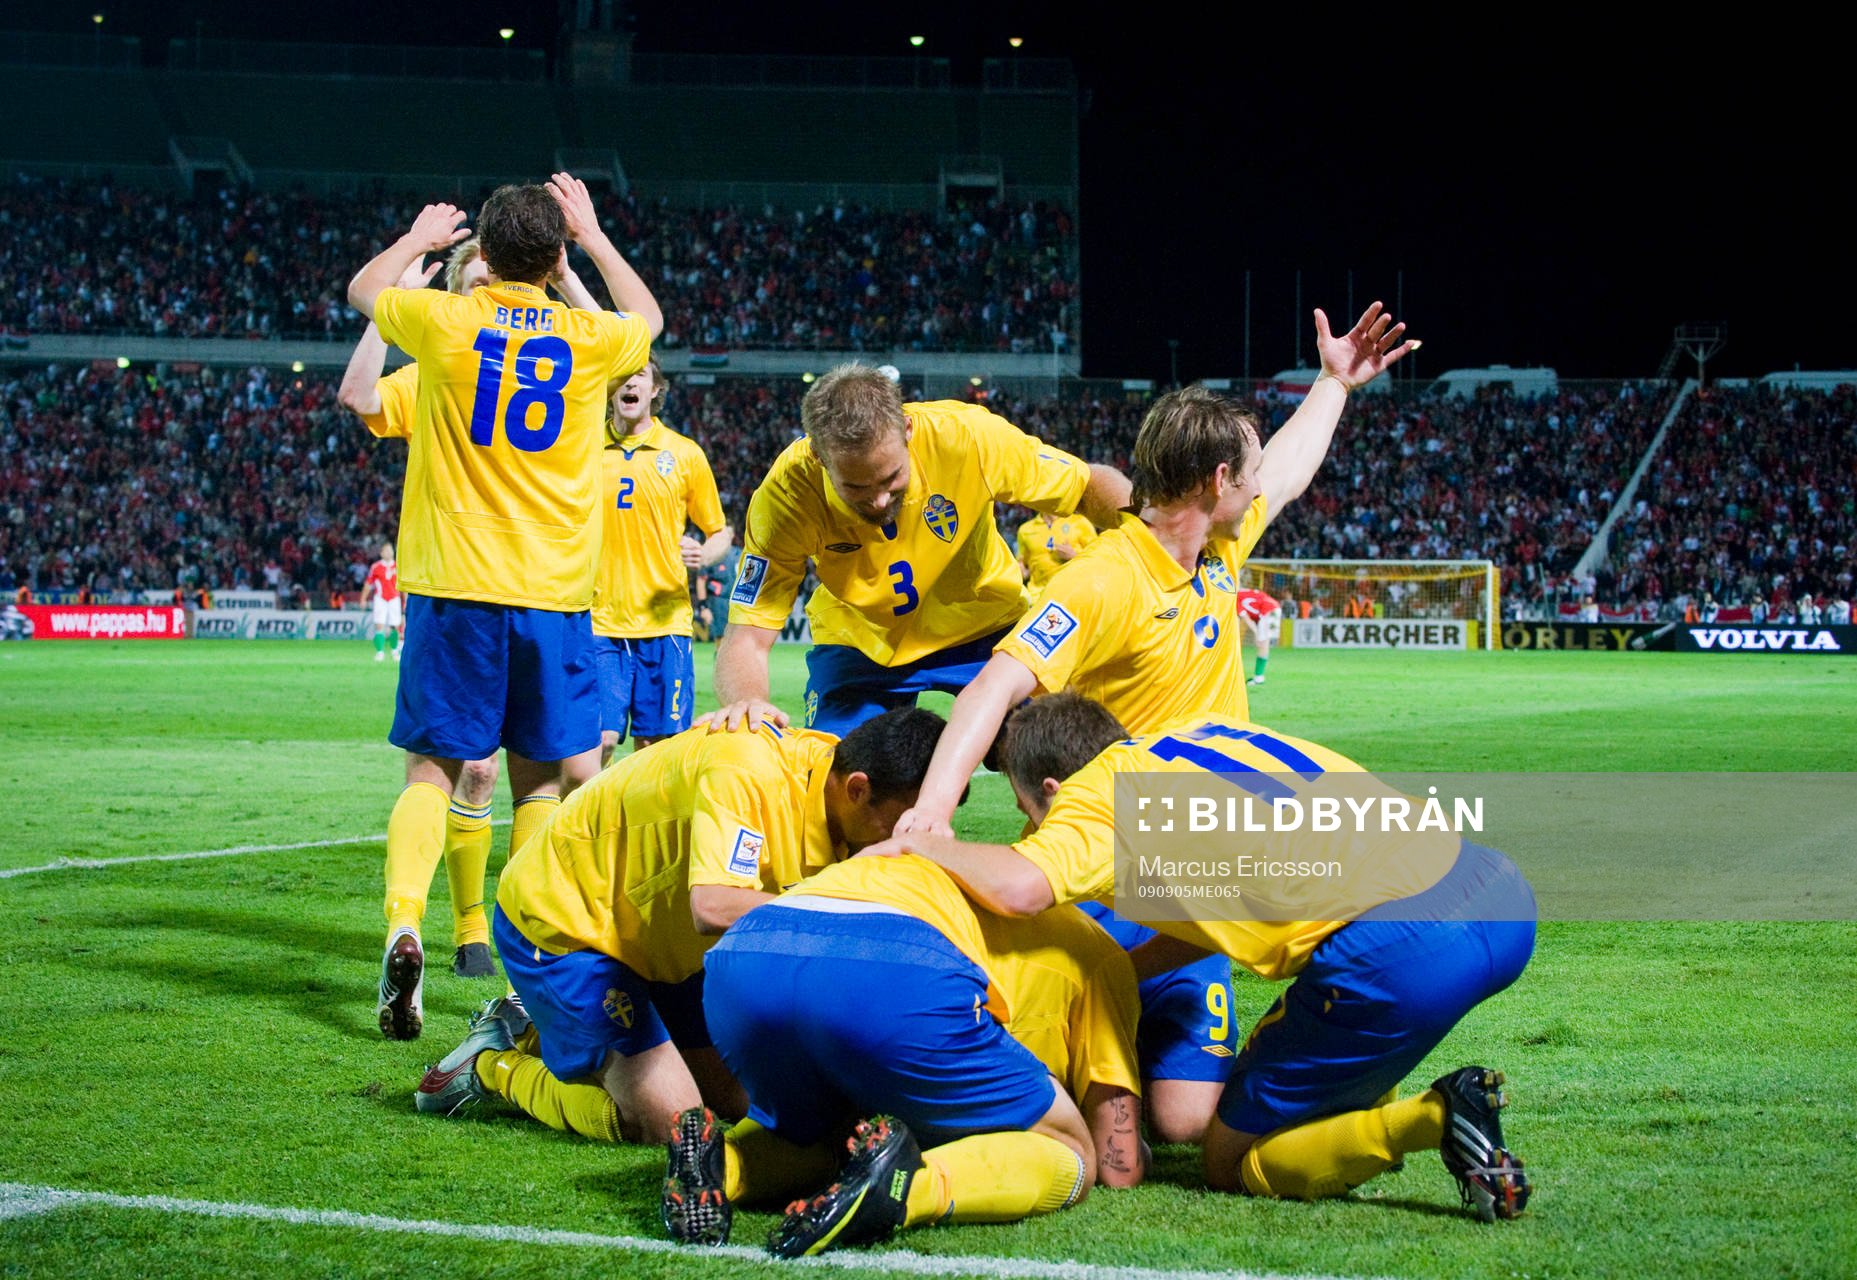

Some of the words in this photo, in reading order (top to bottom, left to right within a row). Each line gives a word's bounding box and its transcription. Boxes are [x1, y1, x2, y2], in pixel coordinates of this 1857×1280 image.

[495, 306, 553, 331] BERG
[470, 327, 573, 452] 18
[617, 477, 634, 509] 2
[888, 560, 919, 617] 3
[51, 609, 167, 637] www.pappas.hu
[172, 608, 186, 635] P
[197, 619, 235, 633] MTD
[256, 619, 295, 633] MTD
[316, 620, 354, 634] MTD
[1502, 622, 1635, 650] ÖRLEY
[1690, 628, 1840, 650] VOLVIA
[1147, 722, 1326, 810] 11
[1206, 982, 1229, 1041] 9
